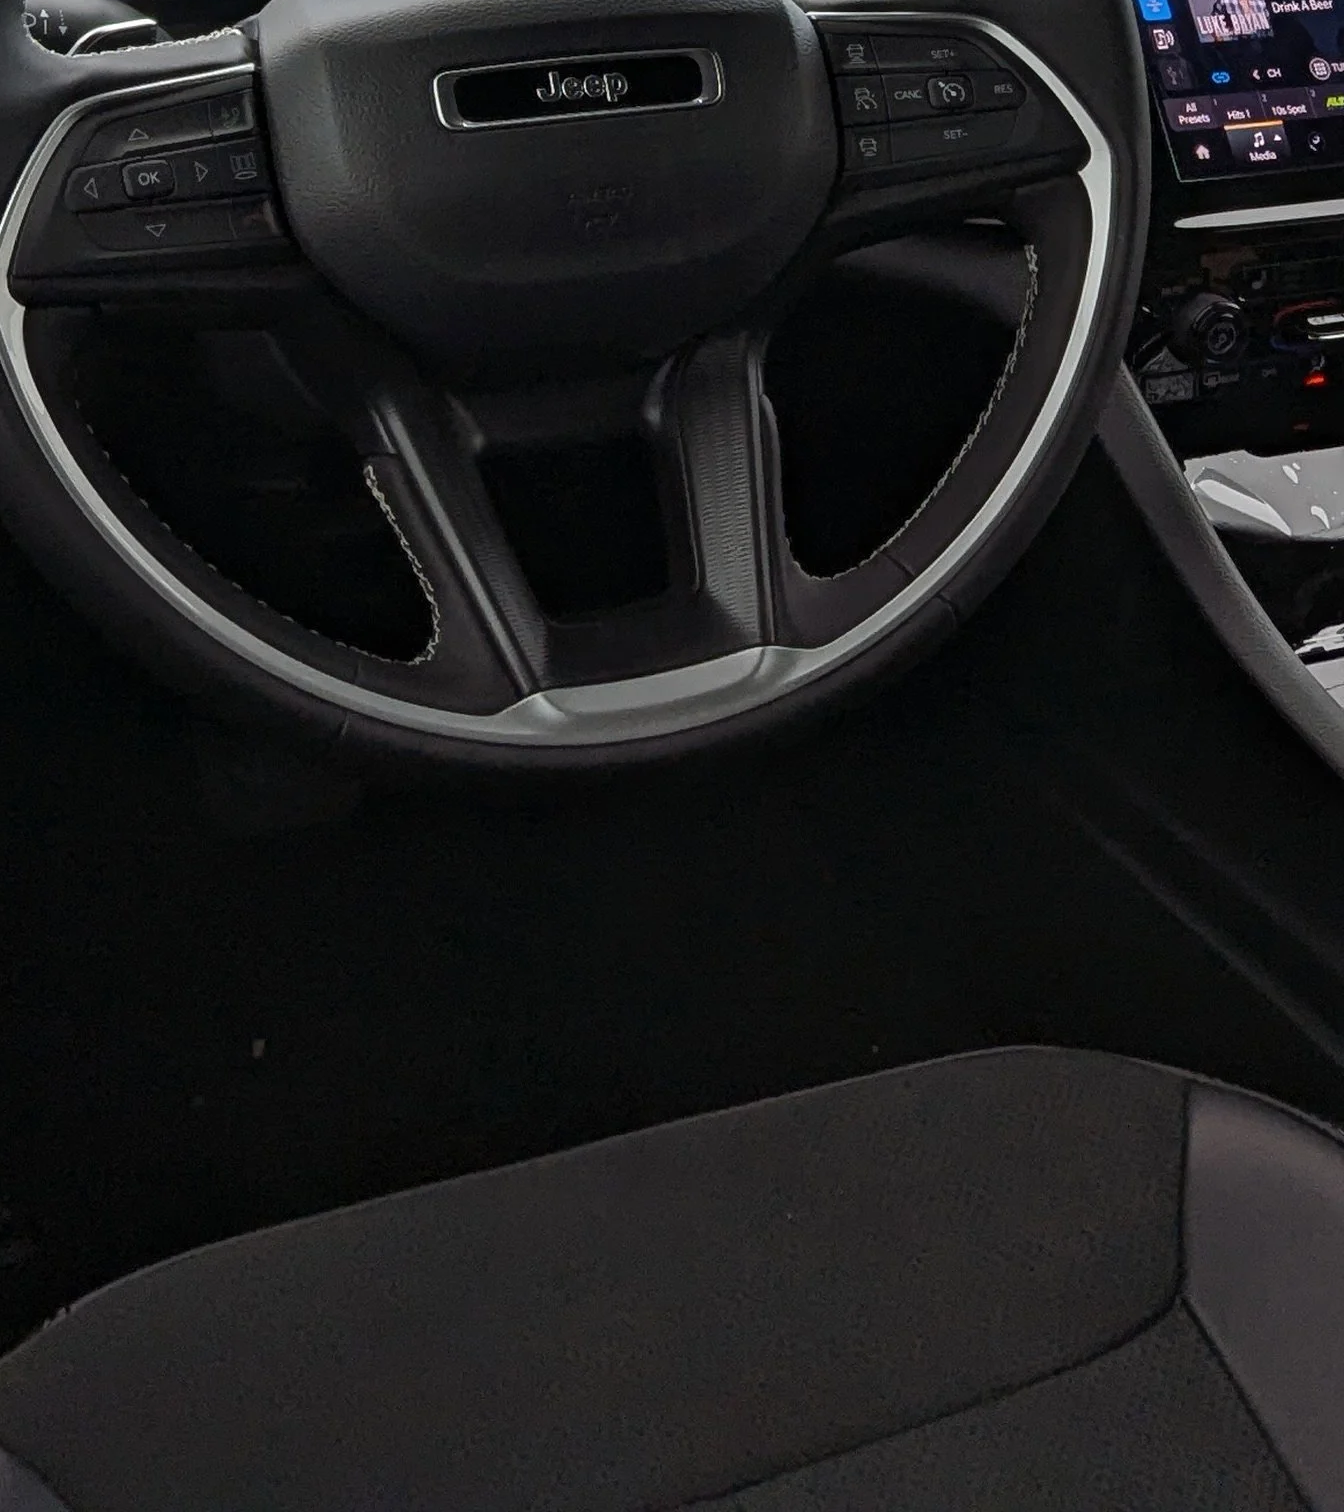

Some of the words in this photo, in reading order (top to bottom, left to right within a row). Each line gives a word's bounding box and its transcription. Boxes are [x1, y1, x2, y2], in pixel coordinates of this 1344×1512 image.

[1270, 0, 1301, 14] Drink
[1301, 0, 1310, 11] A
[1196, 15, 1229, 36] LUKE
[1231, 12, 1271, 32] BRYAN
[1266, 67, 1282, 79] CH
[536, 71, 629, 103] Jeep
[993, 83, 1014, 95] RES
[893, 89, 923, 101] CANC
[1185, 102, 1198, 113] All
[1177, 113, 1211, 126] Presets
[1226, 109, 1246, 121] Hits
[1248, 150, 1278, 162] Media
[137, 171, 161, 186] OK
